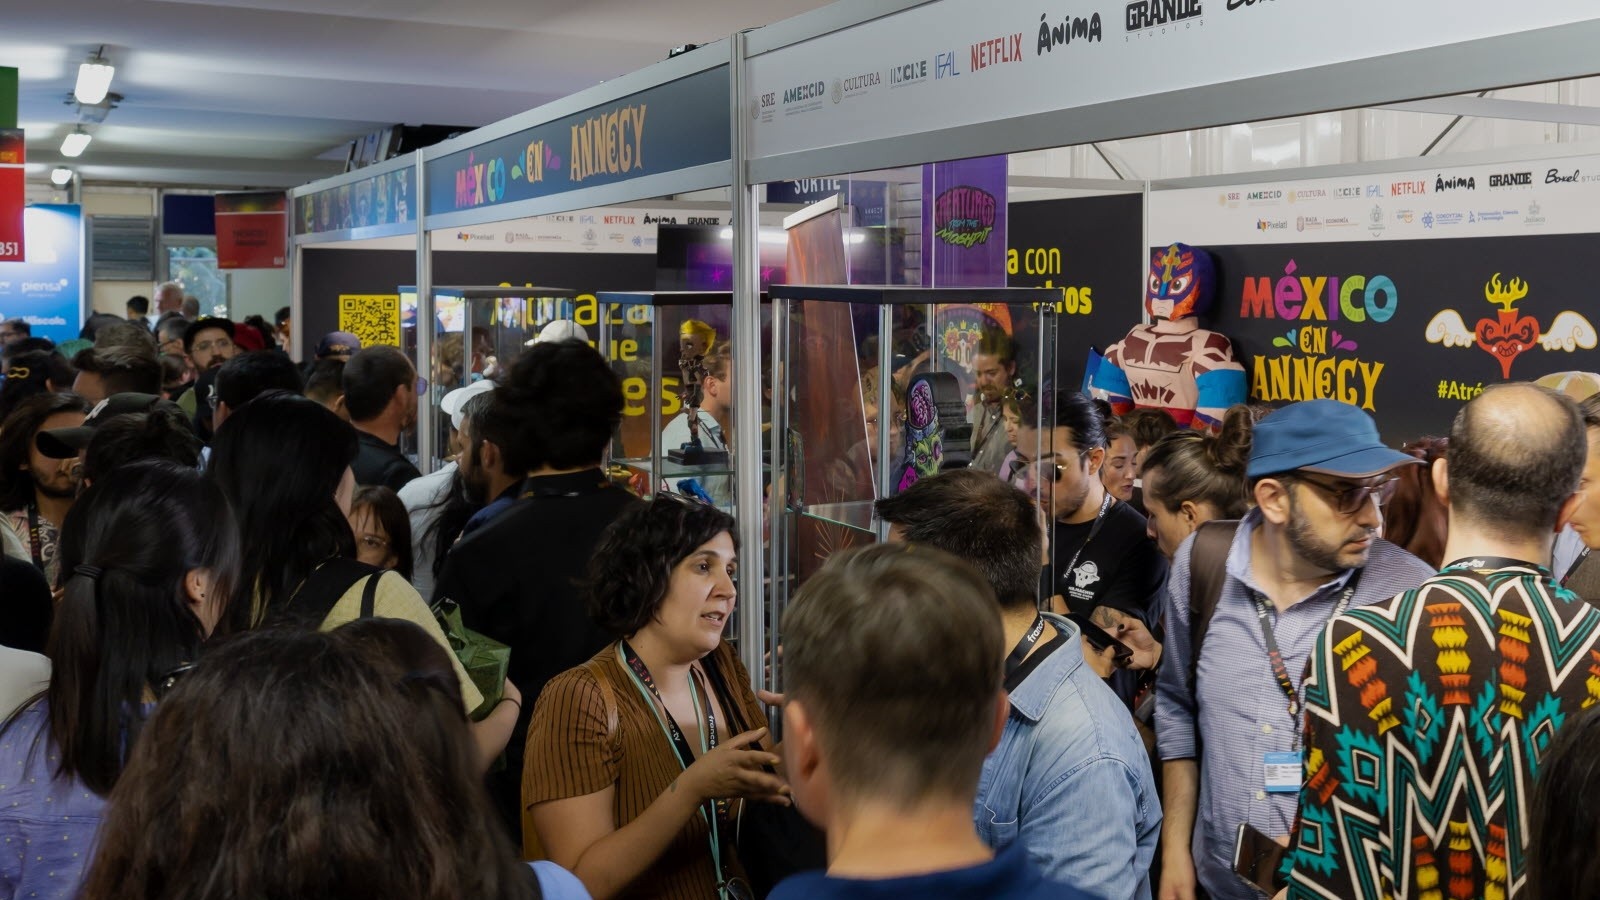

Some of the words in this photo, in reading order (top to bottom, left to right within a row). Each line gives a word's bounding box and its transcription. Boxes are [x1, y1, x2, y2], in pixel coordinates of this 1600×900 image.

[761, 93, 776, 107] SRE
[783, 81, 825, 104] AMEXCID
[844, 72, 880, 92] CULTURA
[935, 50, 960, 80] IFAL
[971, 33, 1022, 72] NETFLIX
[1126, 0, 1201, 31] GRANDE
[526, 140, 543, 184] EN
[570, 104, 647, 182] ANNECY
[1297, 189, 1326, 198] CULTURA
[1391, 180, 1426, 196] NETFLIX
[1489, 172, 1532, 187] GRANDE
[1545, 168, 1580, 184] Boxel
[603, 215, 635, 224] NETFLIX
[687, 217, 720, 226] GRANDE
[1025, 247, 1061, 275] con
[1300, 324, 1328, 355] EN
[1251, 353, 1385, 412] ANNECY
